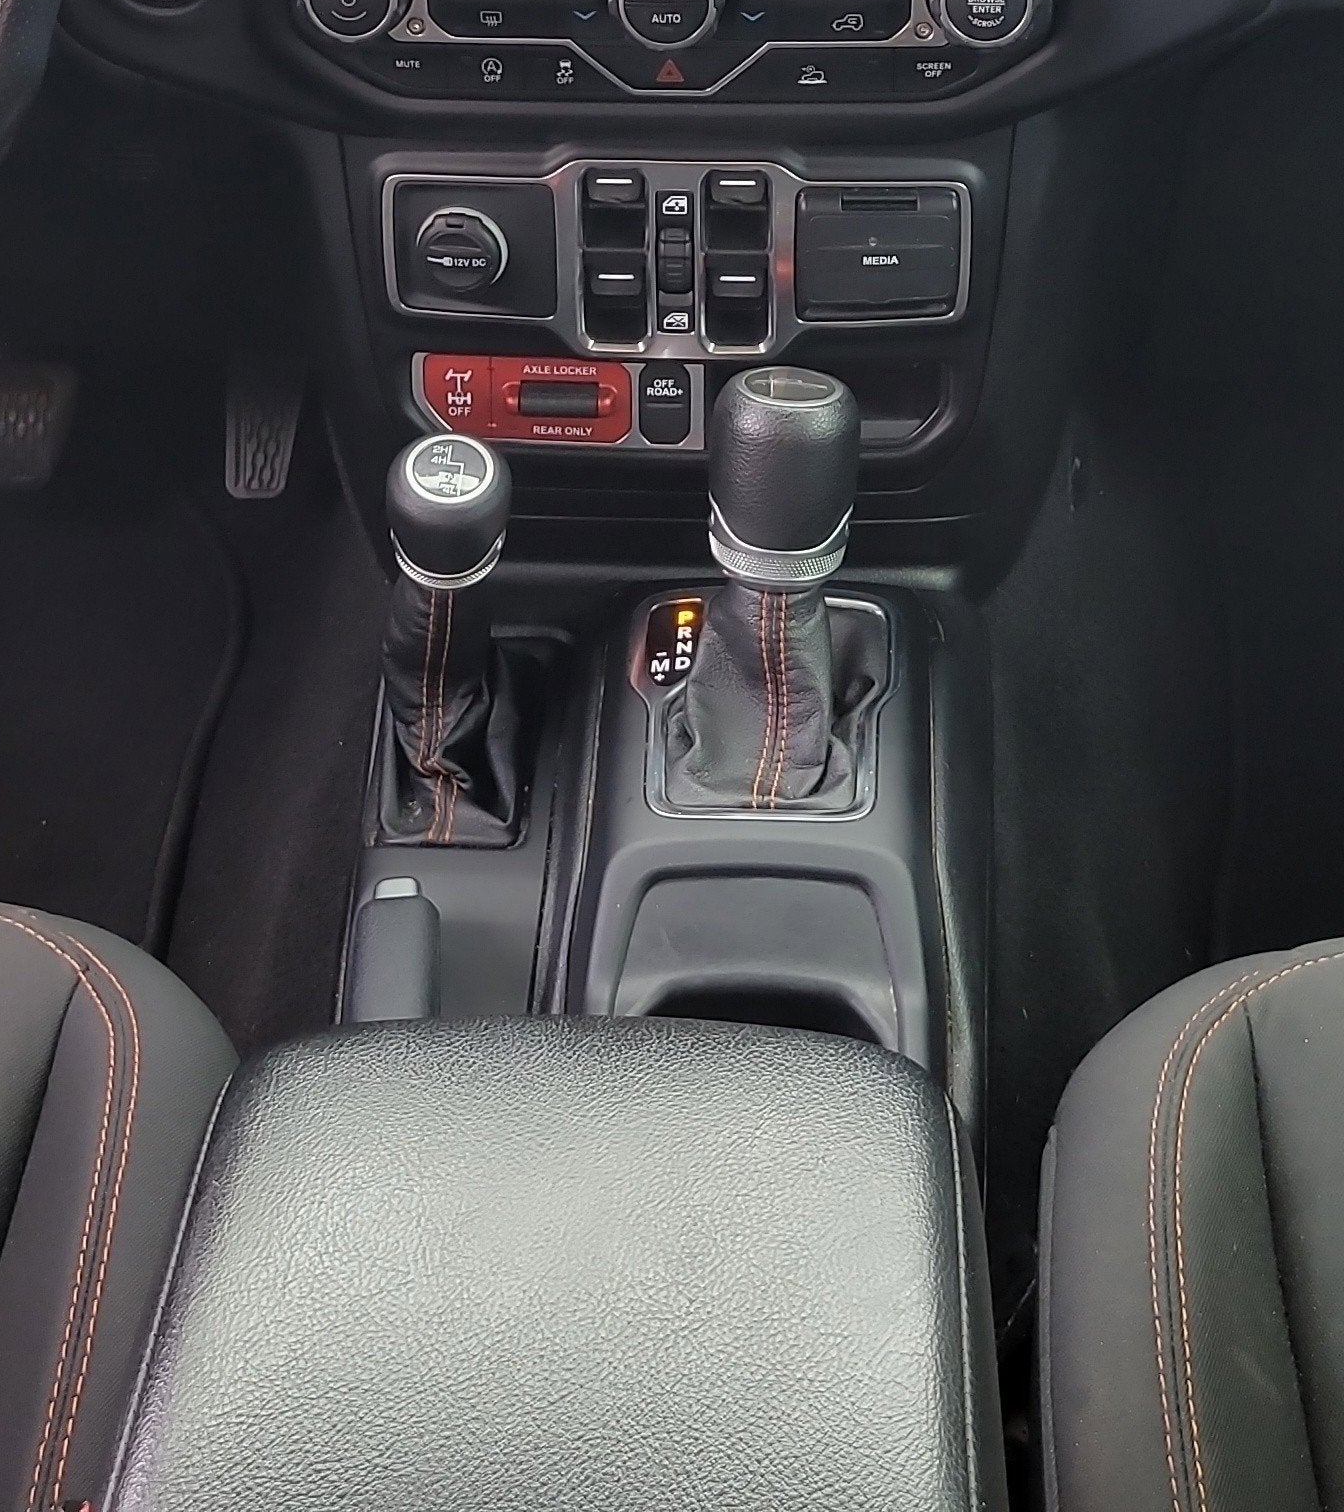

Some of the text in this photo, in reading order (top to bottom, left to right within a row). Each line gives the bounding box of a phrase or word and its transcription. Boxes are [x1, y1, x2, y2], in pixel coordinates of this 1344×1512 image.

[972, 5, 1002, 14] ENTER
[651, 13, 681, 24] AUTO
[972, 16, 1002, 28] SCROLL
[395, 60, 420, 69] MUTE
[916, 62, 952, 71] SCREEN
[925, 70, 942, 78] OFF
[557, 77, 574, 85] OFF
[454, 258, 486, 267] 12V DC
[862, 255, 899, 266] MEDIA
[523, 365, 597, 376] AXLE LOCKER
[653, 379, 675, 388] OFF
[448, 407, 471, 417] OFF
[533, 425, 592, 437] REAR ONLY
[432, 445, 449, 454] 2H
[430, 455, 447, 465] 4H
[678, 610, 694, 625] P
[677, 626, 693, 640] R
[676, 640, 693, 655] N
[650, 658, 671, 673] M
[674, 656, 691, 670] D
